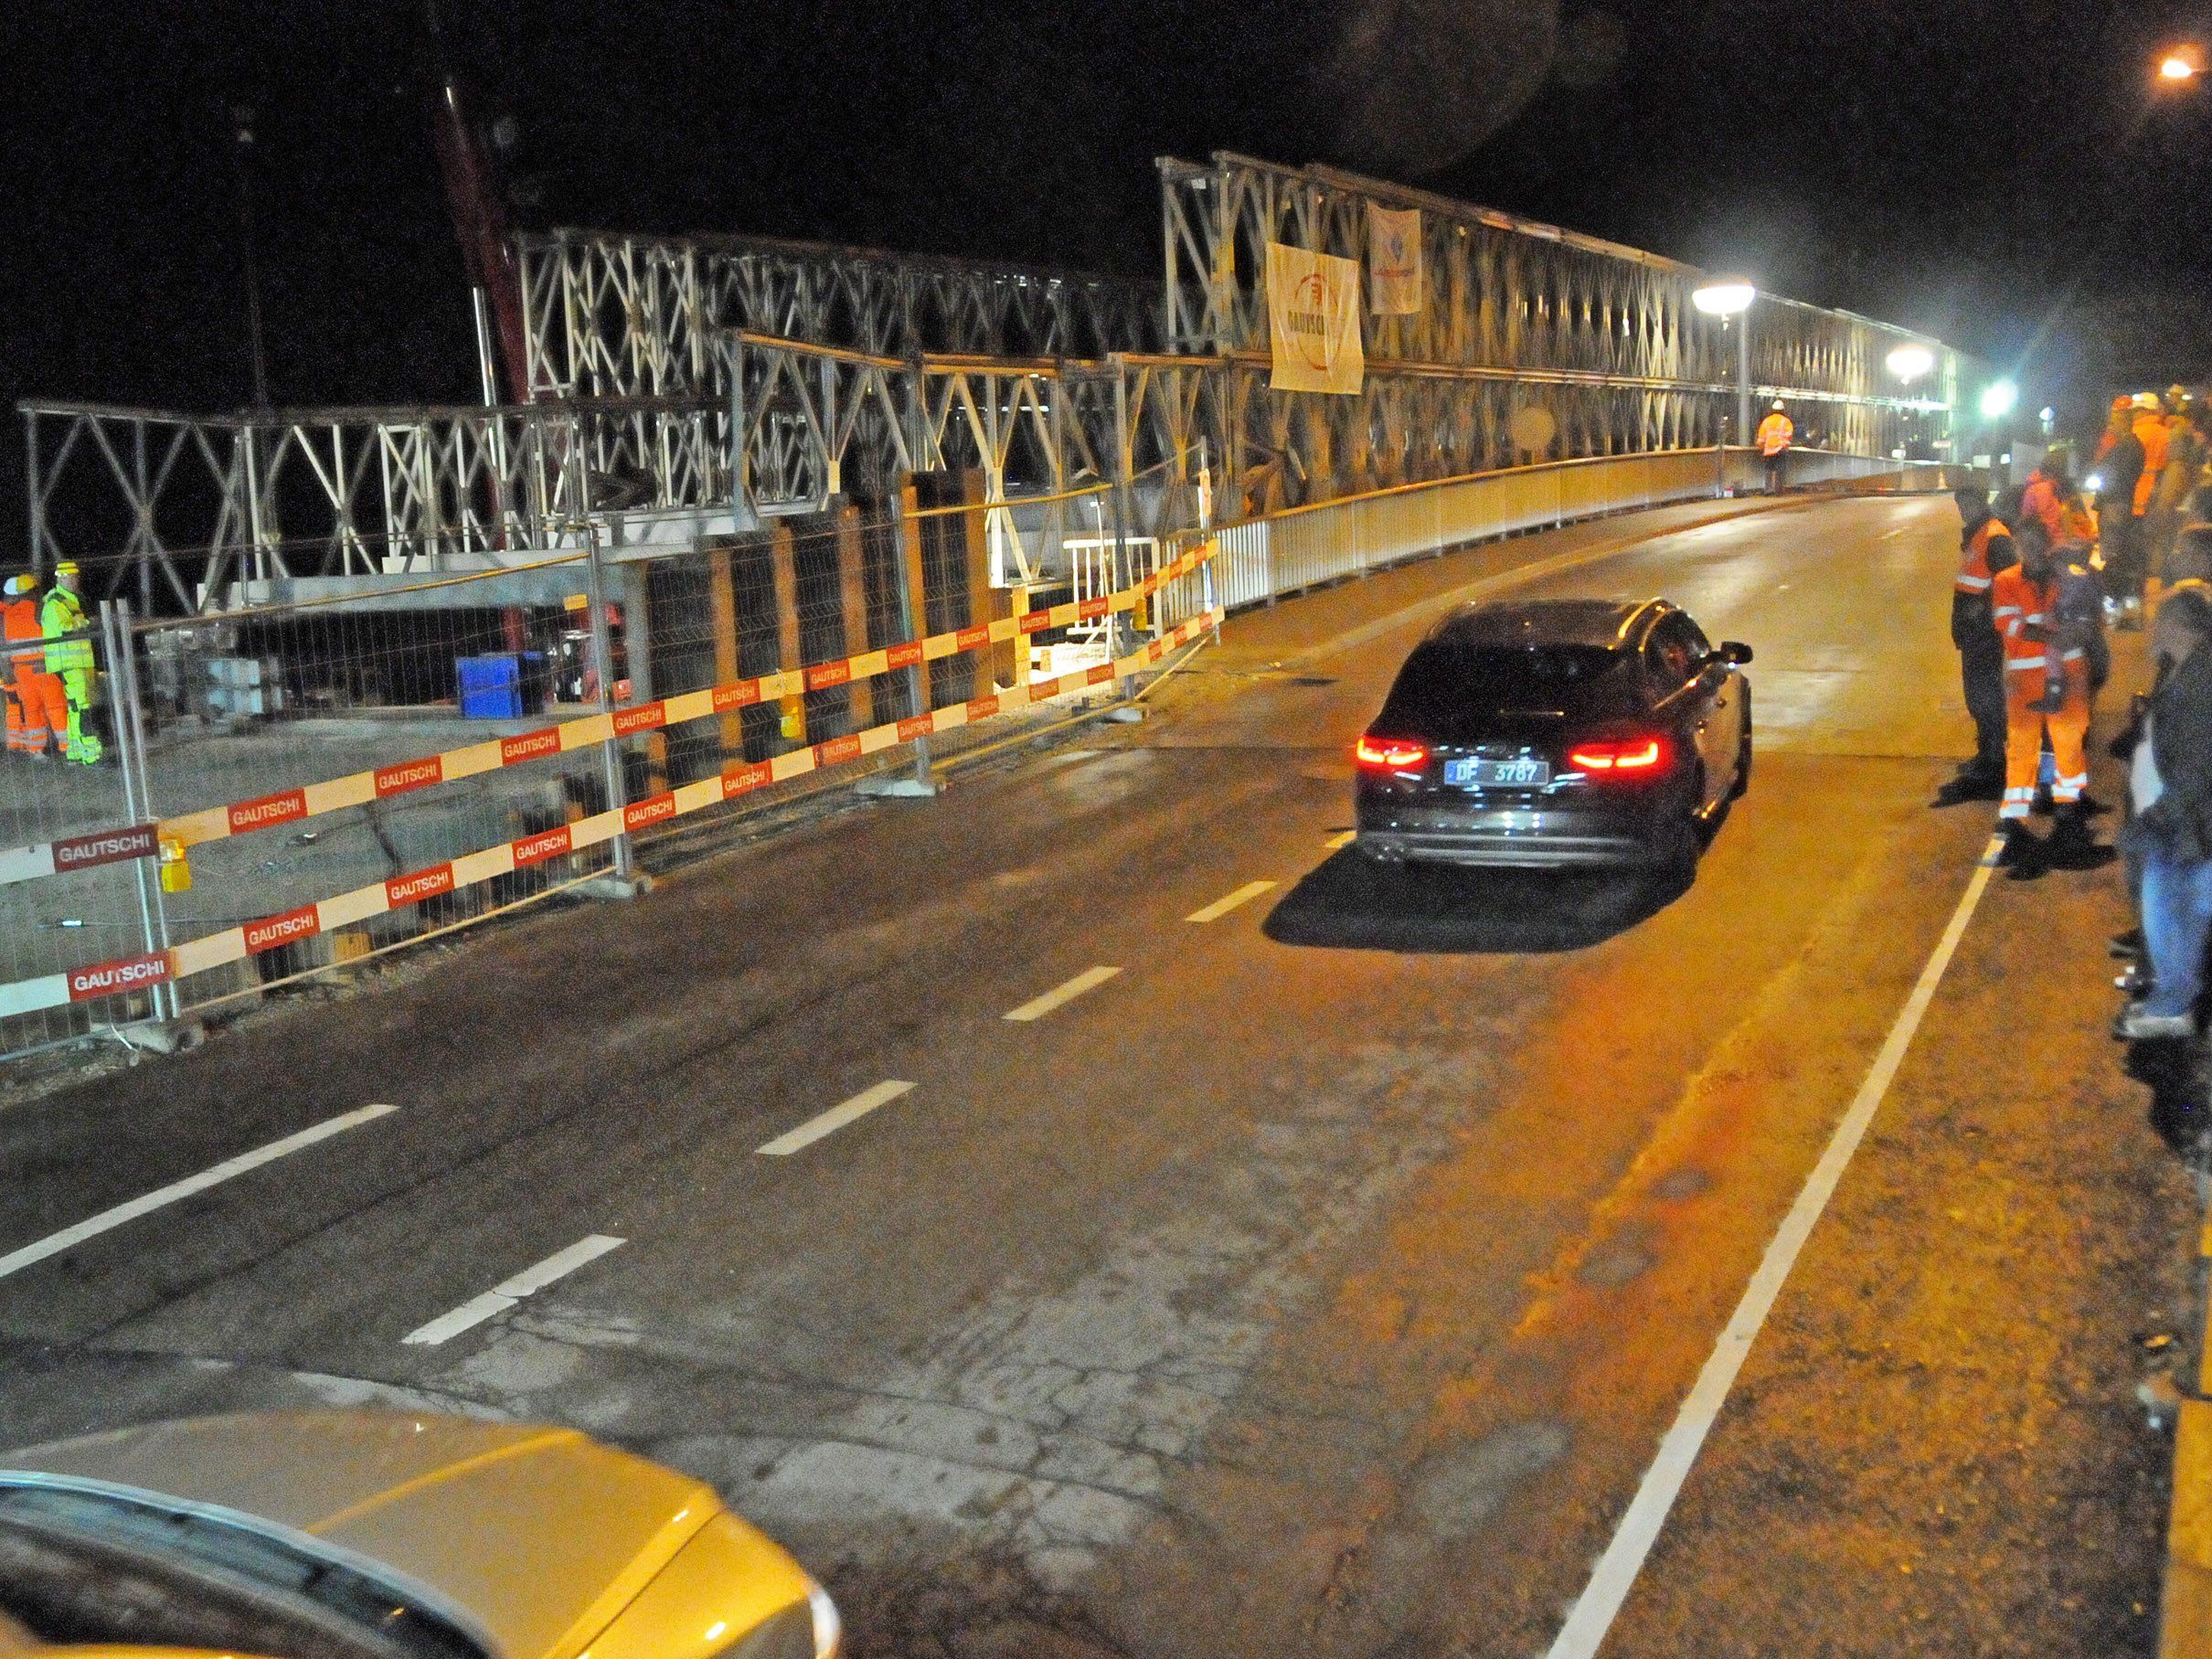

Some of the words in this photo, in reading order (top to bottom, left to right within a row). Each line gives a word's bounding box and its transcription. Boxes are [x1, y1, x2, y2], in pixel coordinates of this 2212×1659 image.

[811, 668, 847, 685] GAUTSCHI
[714, 686, 756, 706] GAUTSCHI
[616, 707, 663, 730] GAUTSCHI
[504, 733, 557, 758] GAUTSCHI
[378, 763, 438, 790] GAUTSCHI
[724, 769, 766, 792] GAUTSCHI
[232, 798, 300, 826] GAUTSCHI
[627, 800, 674, 824] GAUTSCHI
[58, 834, 151, 863] GAUTSCHI
[516, 834, 569, 860] GAUTSCHI
[391, 871, 449, 900] GAUTSCHI
[248, 915, 314, 946] GAUTSCHI
[74, 960, 165, 992] GAUTSCHI
